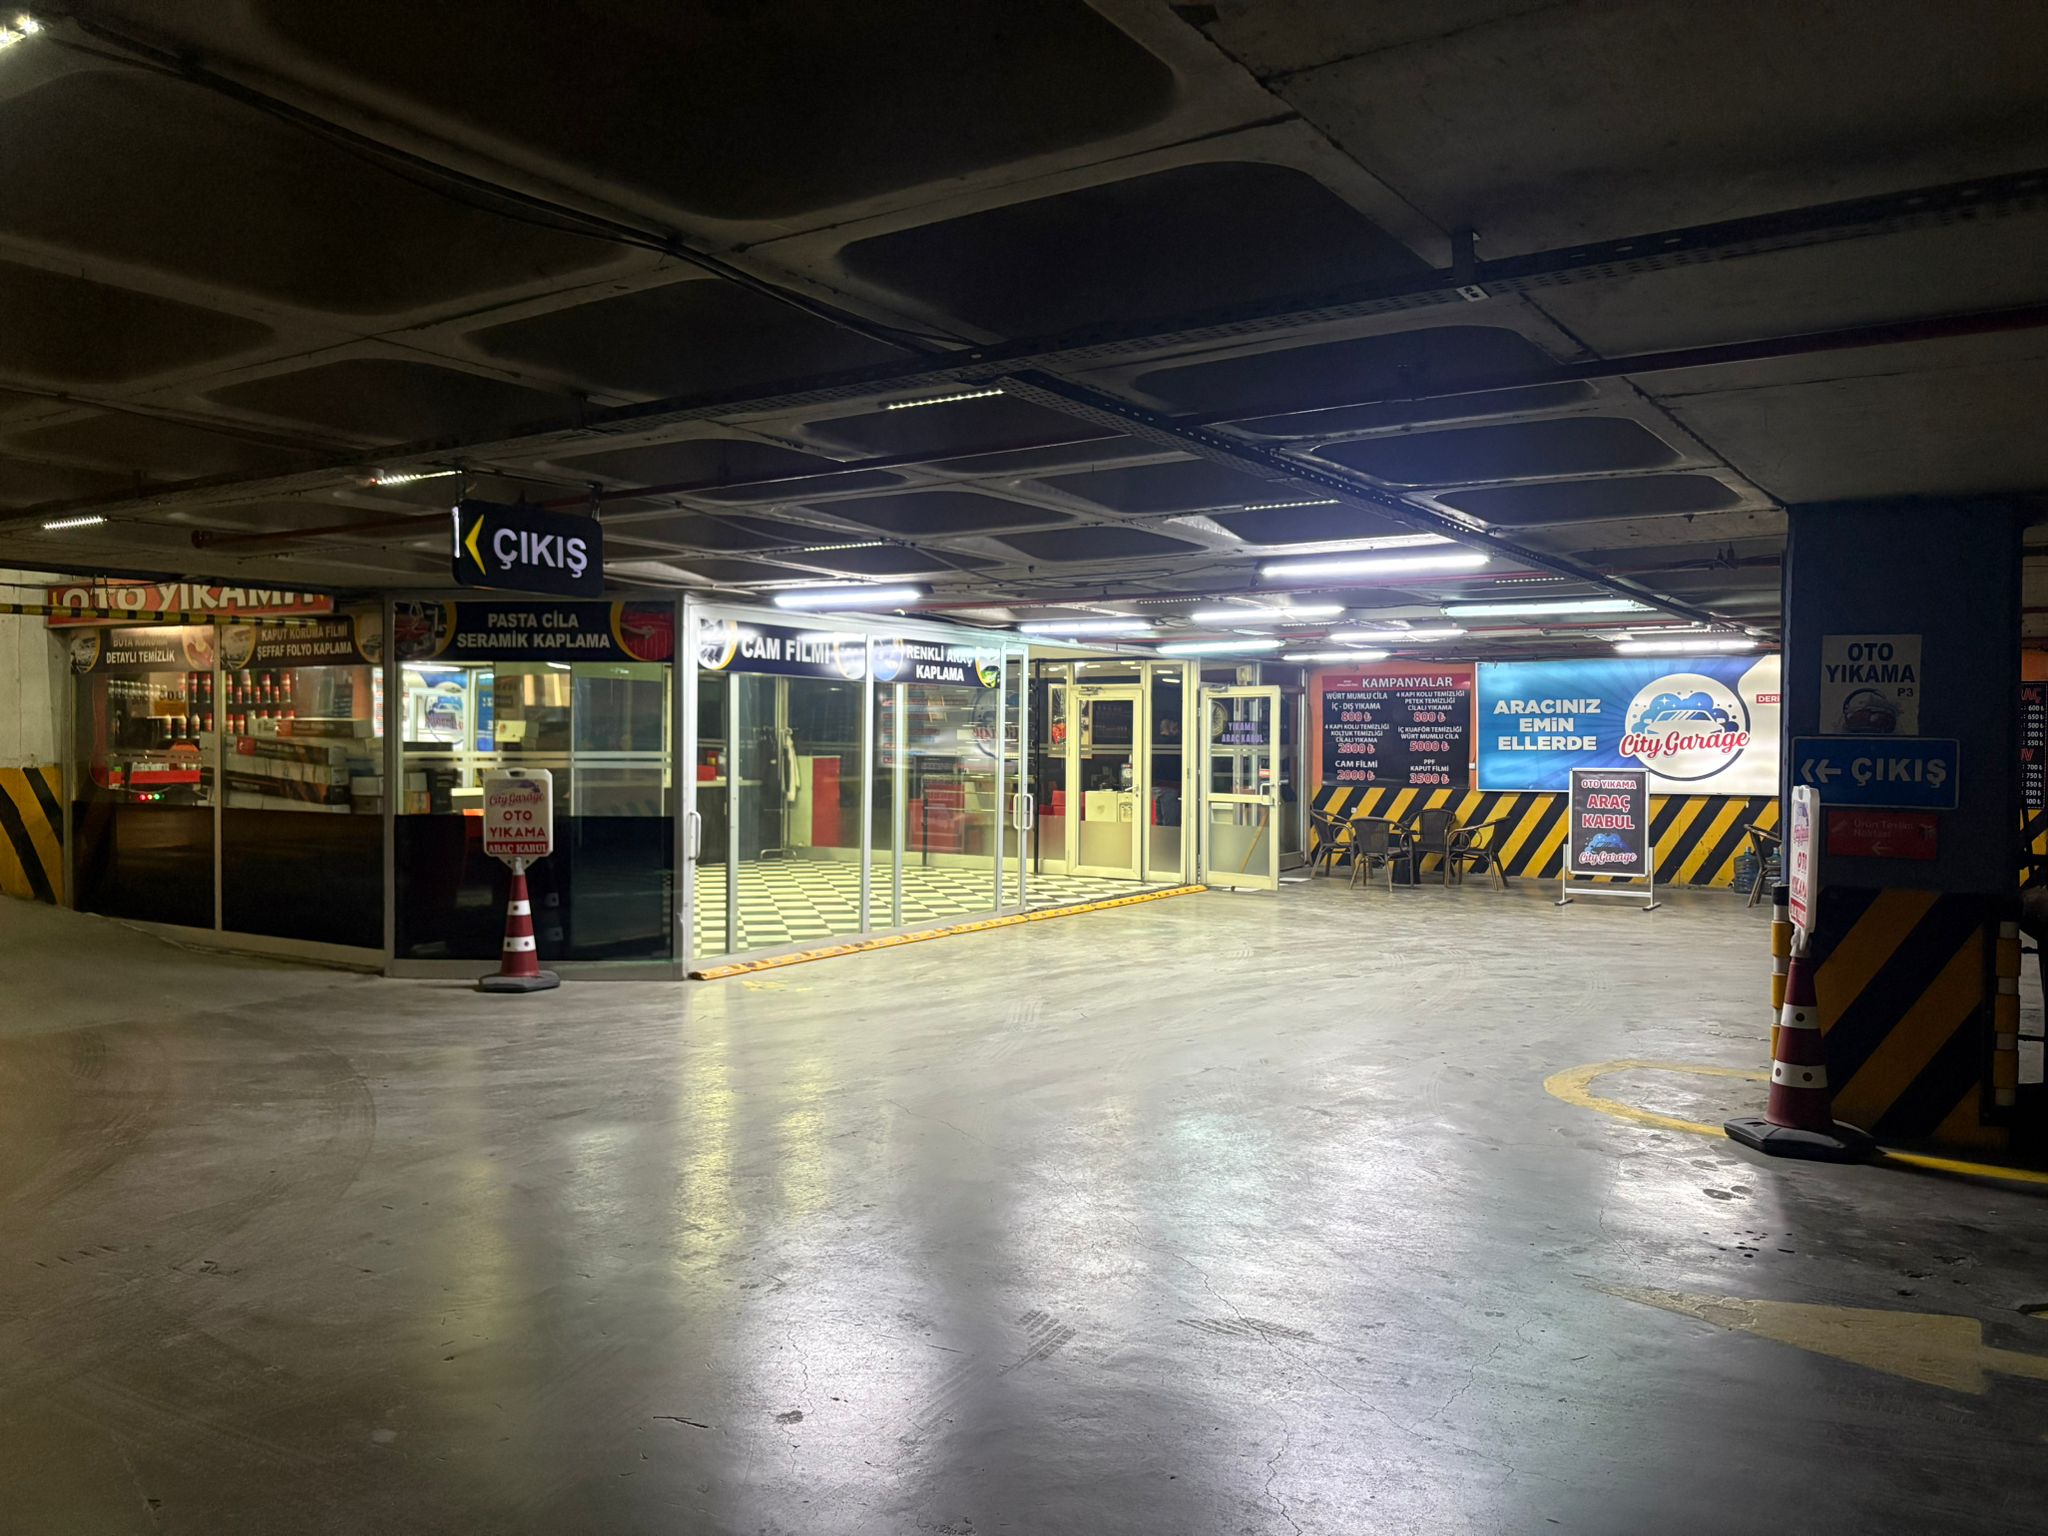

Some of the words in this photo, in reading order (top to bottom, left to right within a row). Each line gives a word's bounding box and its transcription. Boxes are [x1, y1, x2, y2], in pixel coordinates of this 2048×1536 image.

[493, 528, 588, 578] ÇIKIŞ
[63, 587, 147, 610] OTO
[487, 612, 538, 628] PASTA
[542, 609, 579, 628] CİLA
[261, 629, 288, 641] KAPUT
[456, 630, 529, 649] SERAMİK
[533, 634, 611, 649] KAPLAMA
[257, 644, 285, 661] ŞEFFAF
[286, 643, 312, 656] FOLYO
[313, 641, 353, 655] KAPLAMA
[741, 635, 781, 660] CAM
[906, 645, 945, 662] RENKLİ
[1847, 642, 1894, 662] OTO
[106, 651, 137, 664] DETAYLI
[138, 648, 176, 663] TEMİZLİK
[916, 664, 965, 682] KAPLAMA
[1825, 664, 1916, 683] YIKAMA
[1362, 677, 1453, 688] KAMPANYALAR
[1326, 692, 1346, 700] WÜRT
[1372, 692, 1388, 700] CİLA
[1897, 687, 1914, 697] P3
[1342, 703, 1353, 712] DIŞ
[1493, 698, 1601, 714] ARACINIZ
[1341, 711, 1362, 722] 800
[1413, 711, 1436, 722] 800
[1337, 743, 1366, 754] 2800
[1409, 741, 1440, 752] 5000
[1497, 735, 1598, 751] ELLERDE
[1620, 733, 1663, 758] City
[1664, 730, 1751, 758] Garage
[1409, 773, 1440, 784] 3500
[1850, 757, 1947, 789] ÇIKIŞ
[1581, 779, 1600, 788] OTO
[1600, 780, 1637, 790] YIKAMA
[1587, 794, 1631, 812] ARAÇ
[503, 810, 532, 821] OTO
[1582, 814, 1636, 830] KABUL
[490, 826, 546, 838] YIKAMA
[488, 844, 514, 854] ARAÇ
[1579, 852, 1598, 866] City
[1598, 851, 1638, 865] Garage
